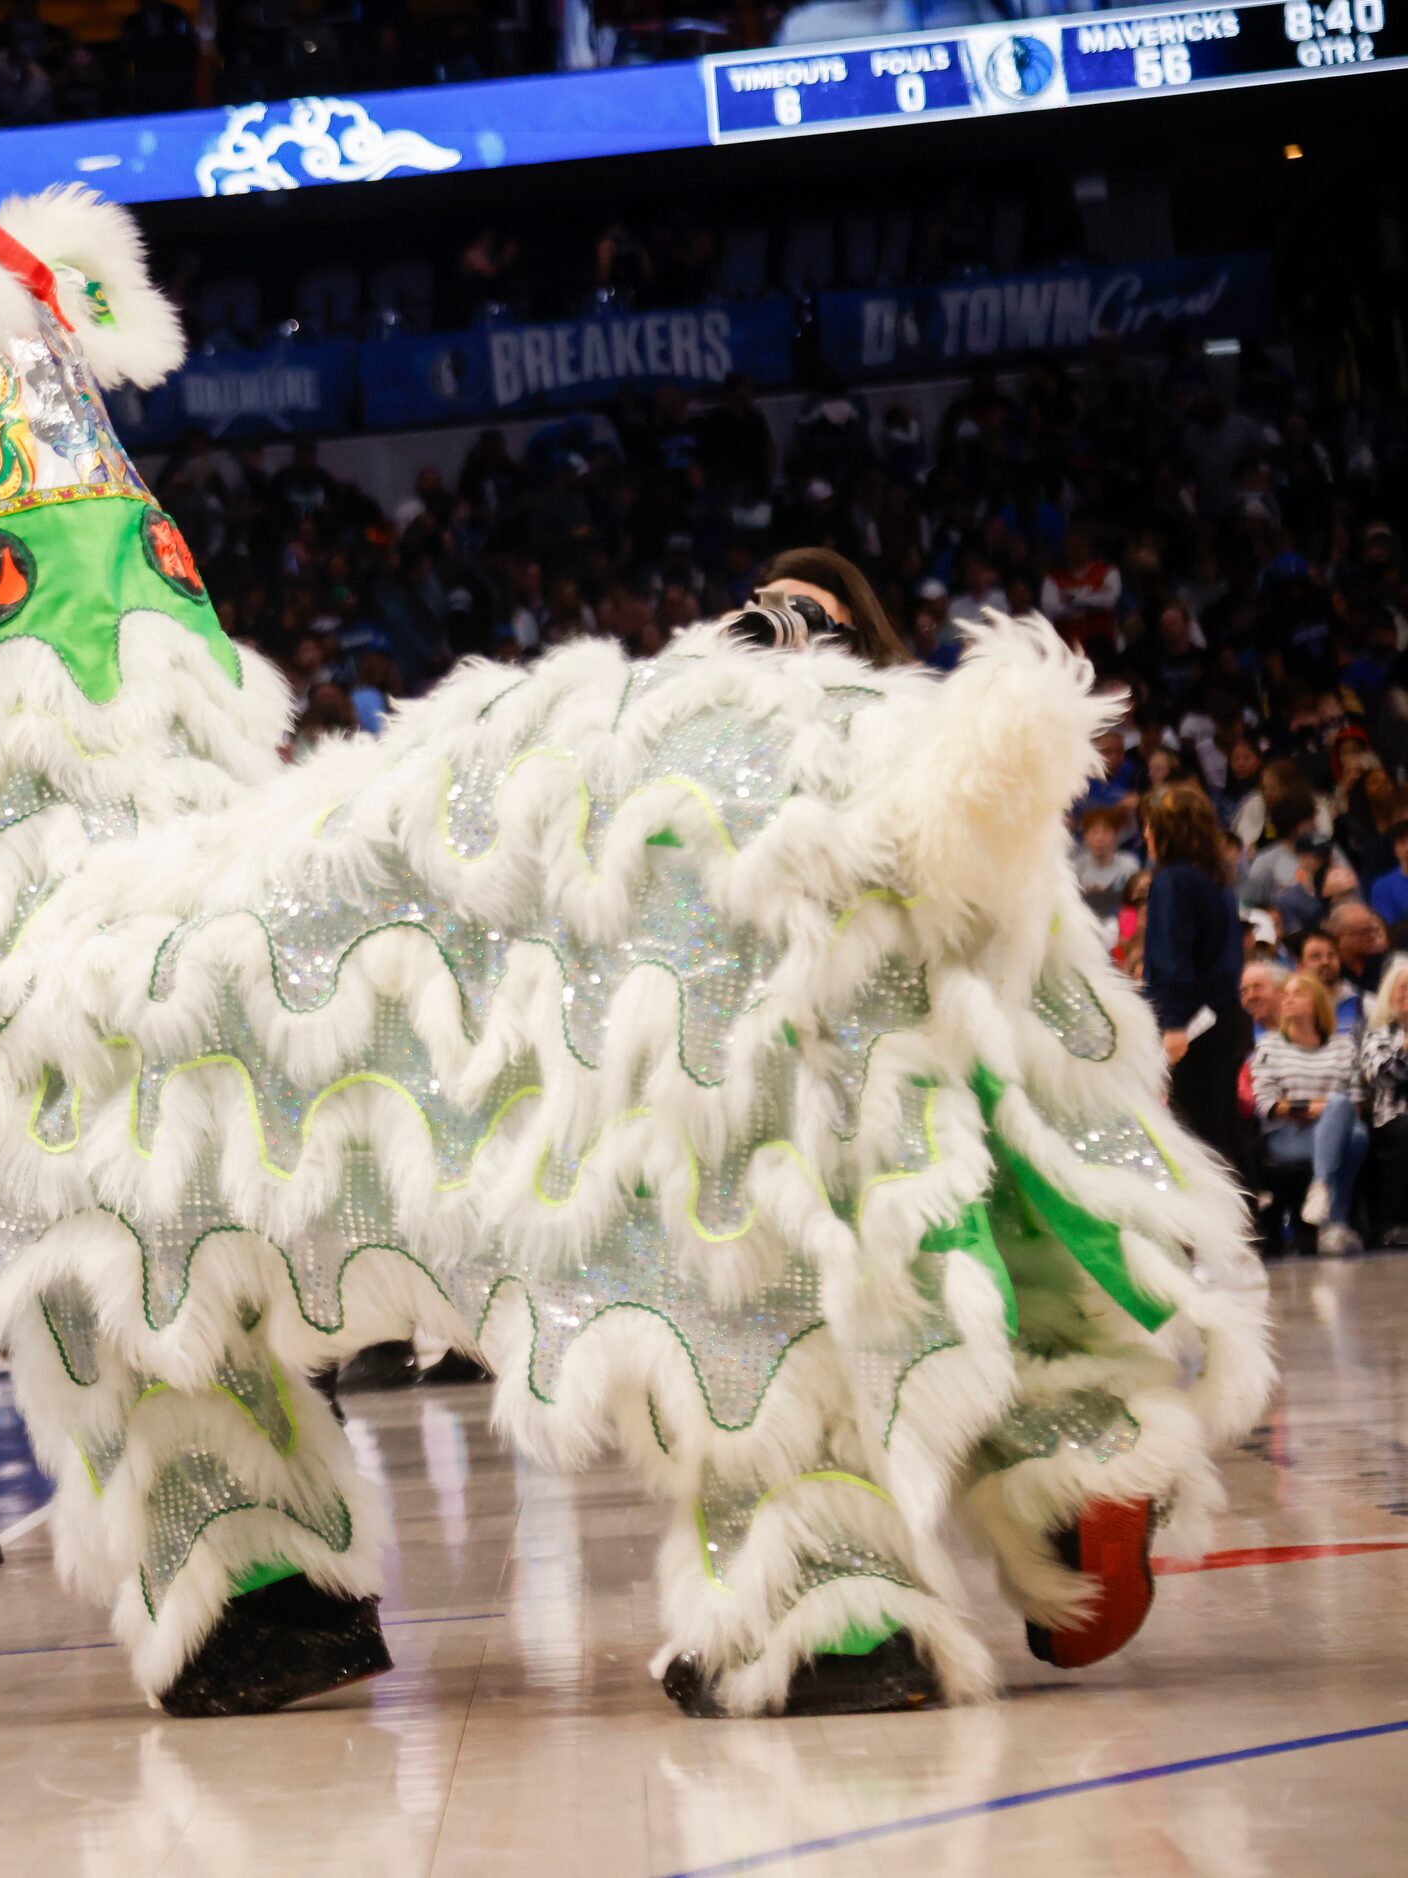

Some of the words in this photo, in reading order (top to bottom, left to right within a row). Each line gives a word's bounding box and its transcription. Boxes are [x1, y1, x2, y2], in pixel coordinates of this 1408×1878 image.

[1077, 9, 1240, 54] MAVERICKS
[1283, 0, 1385, 41] 8:40
[728, 55, 848, 92] TIMEOUTS
[870, 44, 951, 77] FOULS
[1134, 44, 1192, 88] 56
[1297, 37, 1356, 67] QTR
[1356, 33, 1375, 61] 2
[895, 73, 927, 112] 0
[939, 275, 1092, 359] TOWN
[494, 309, 733, 406] BREAKERS
